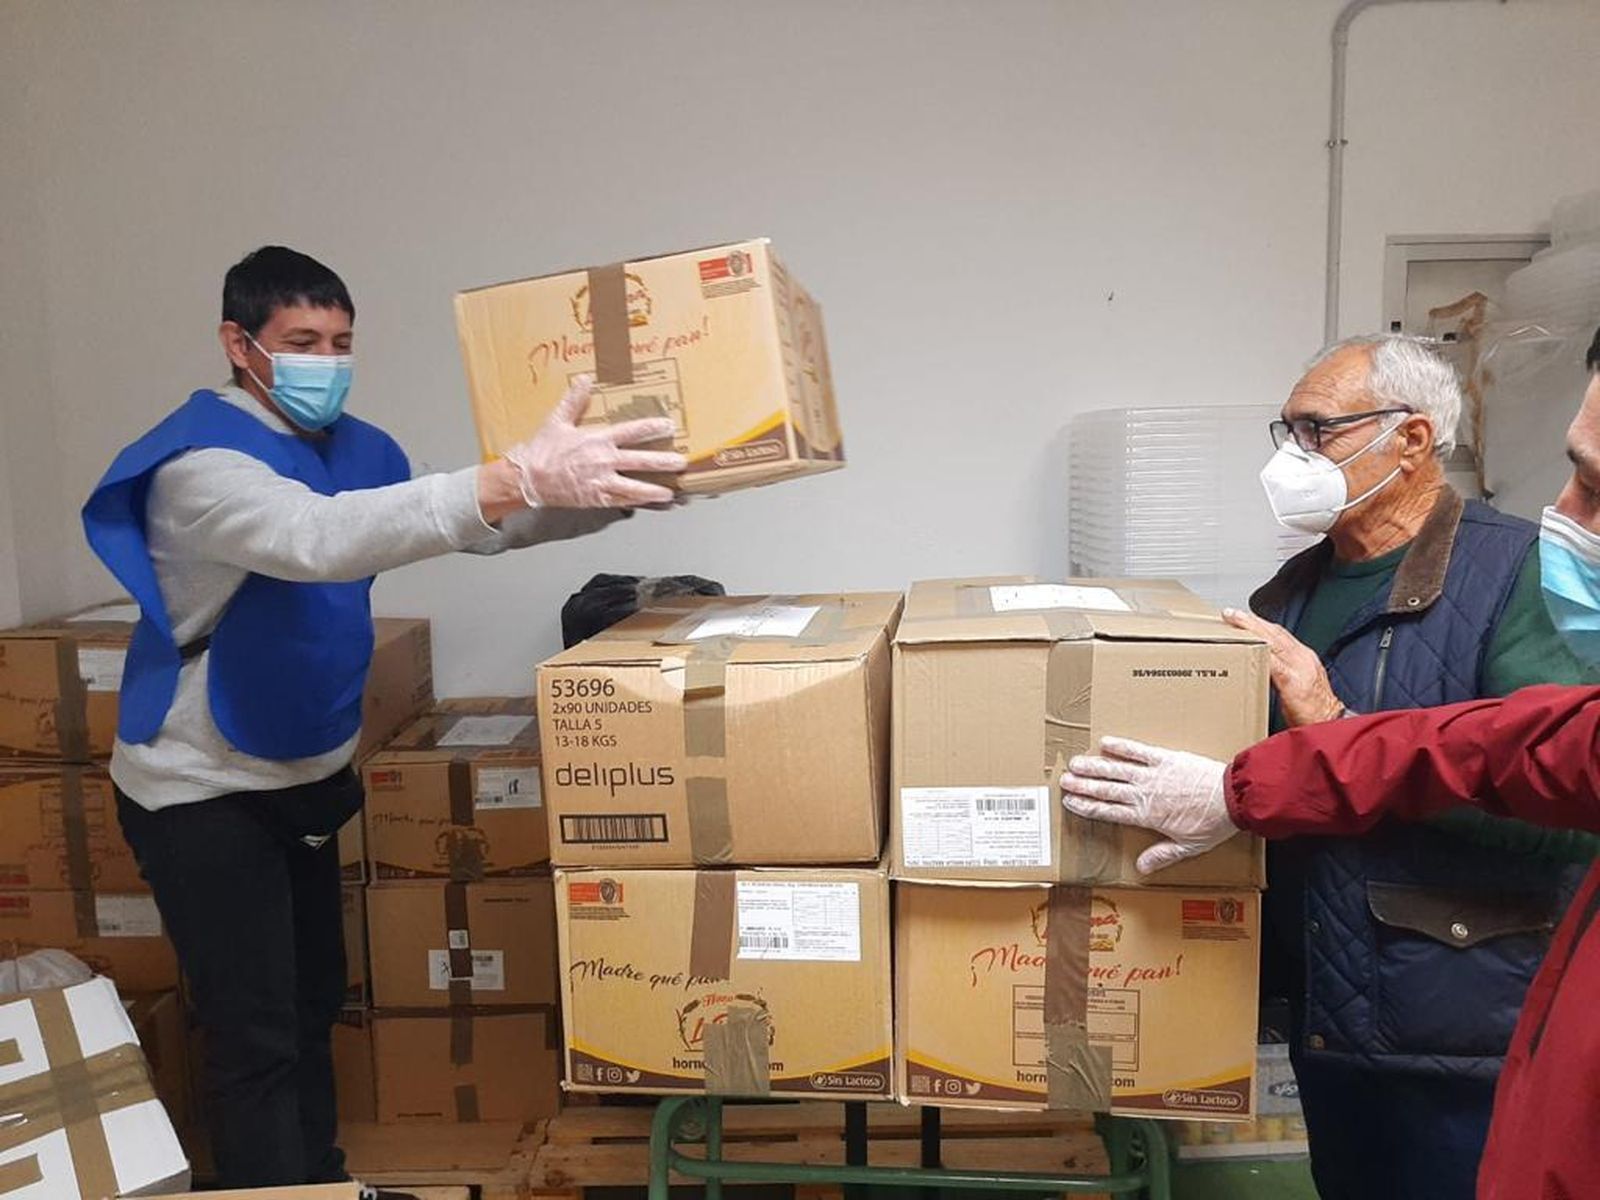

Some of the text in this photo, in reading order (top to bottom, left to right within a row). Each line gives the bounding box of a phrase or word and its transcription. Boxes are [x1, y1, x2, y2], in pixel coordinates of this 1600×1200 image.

[551, 678, 615, 698] 53696
[553, 700, 653, 715] 2x90 UNIDADES
[552, 718, 592, 731] TALLA
[555, 734, 617, 748] 13-18 KGS
[555, 762, 675, 797] deliplus
[1122, 954, 1184, 987] pan!
